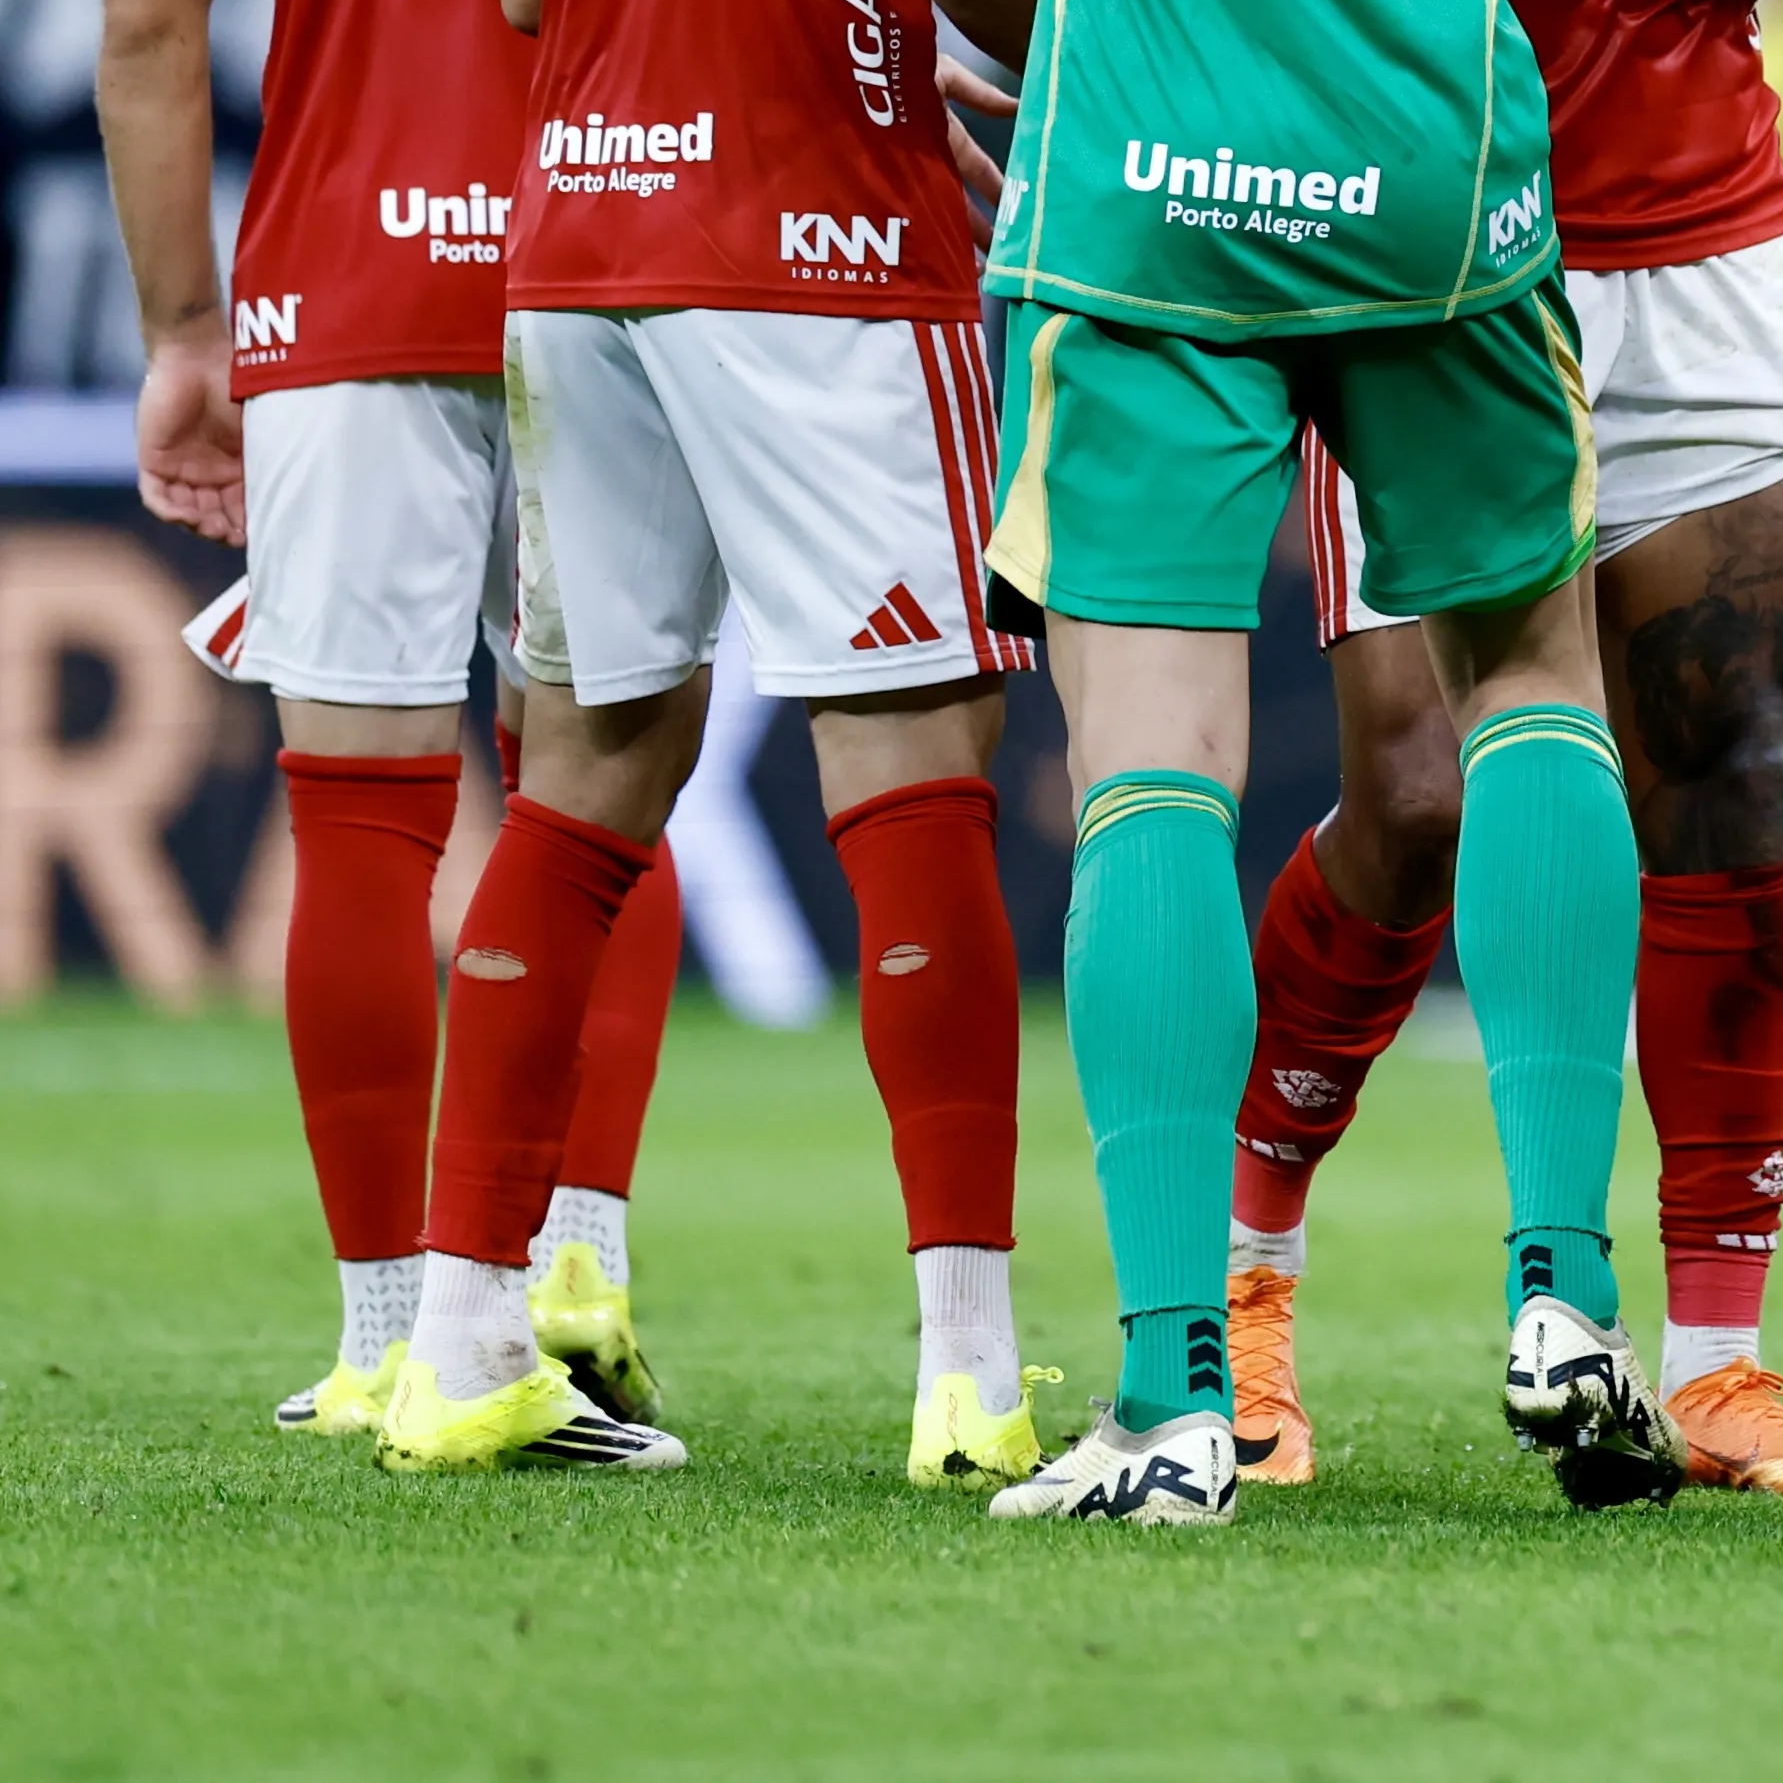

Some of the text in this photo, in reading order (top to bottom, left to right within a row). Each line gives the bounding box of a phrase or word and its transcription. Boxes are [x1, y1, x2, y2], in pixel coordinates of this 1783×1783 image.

[539, 112, 714, 170] Unimed
[547, 166, 676, 198] Porto Alegre
[1123, 140, 1381, 216] Unimed
[1165, 200, 1331, 243] Porto Alegre
[1488, 170, 1542, 255] KNN
[429, 239, 500, 264] Porto
[780, 211, 900, 266] KNN
[791, 267, 889, 284] IDIOMAS
